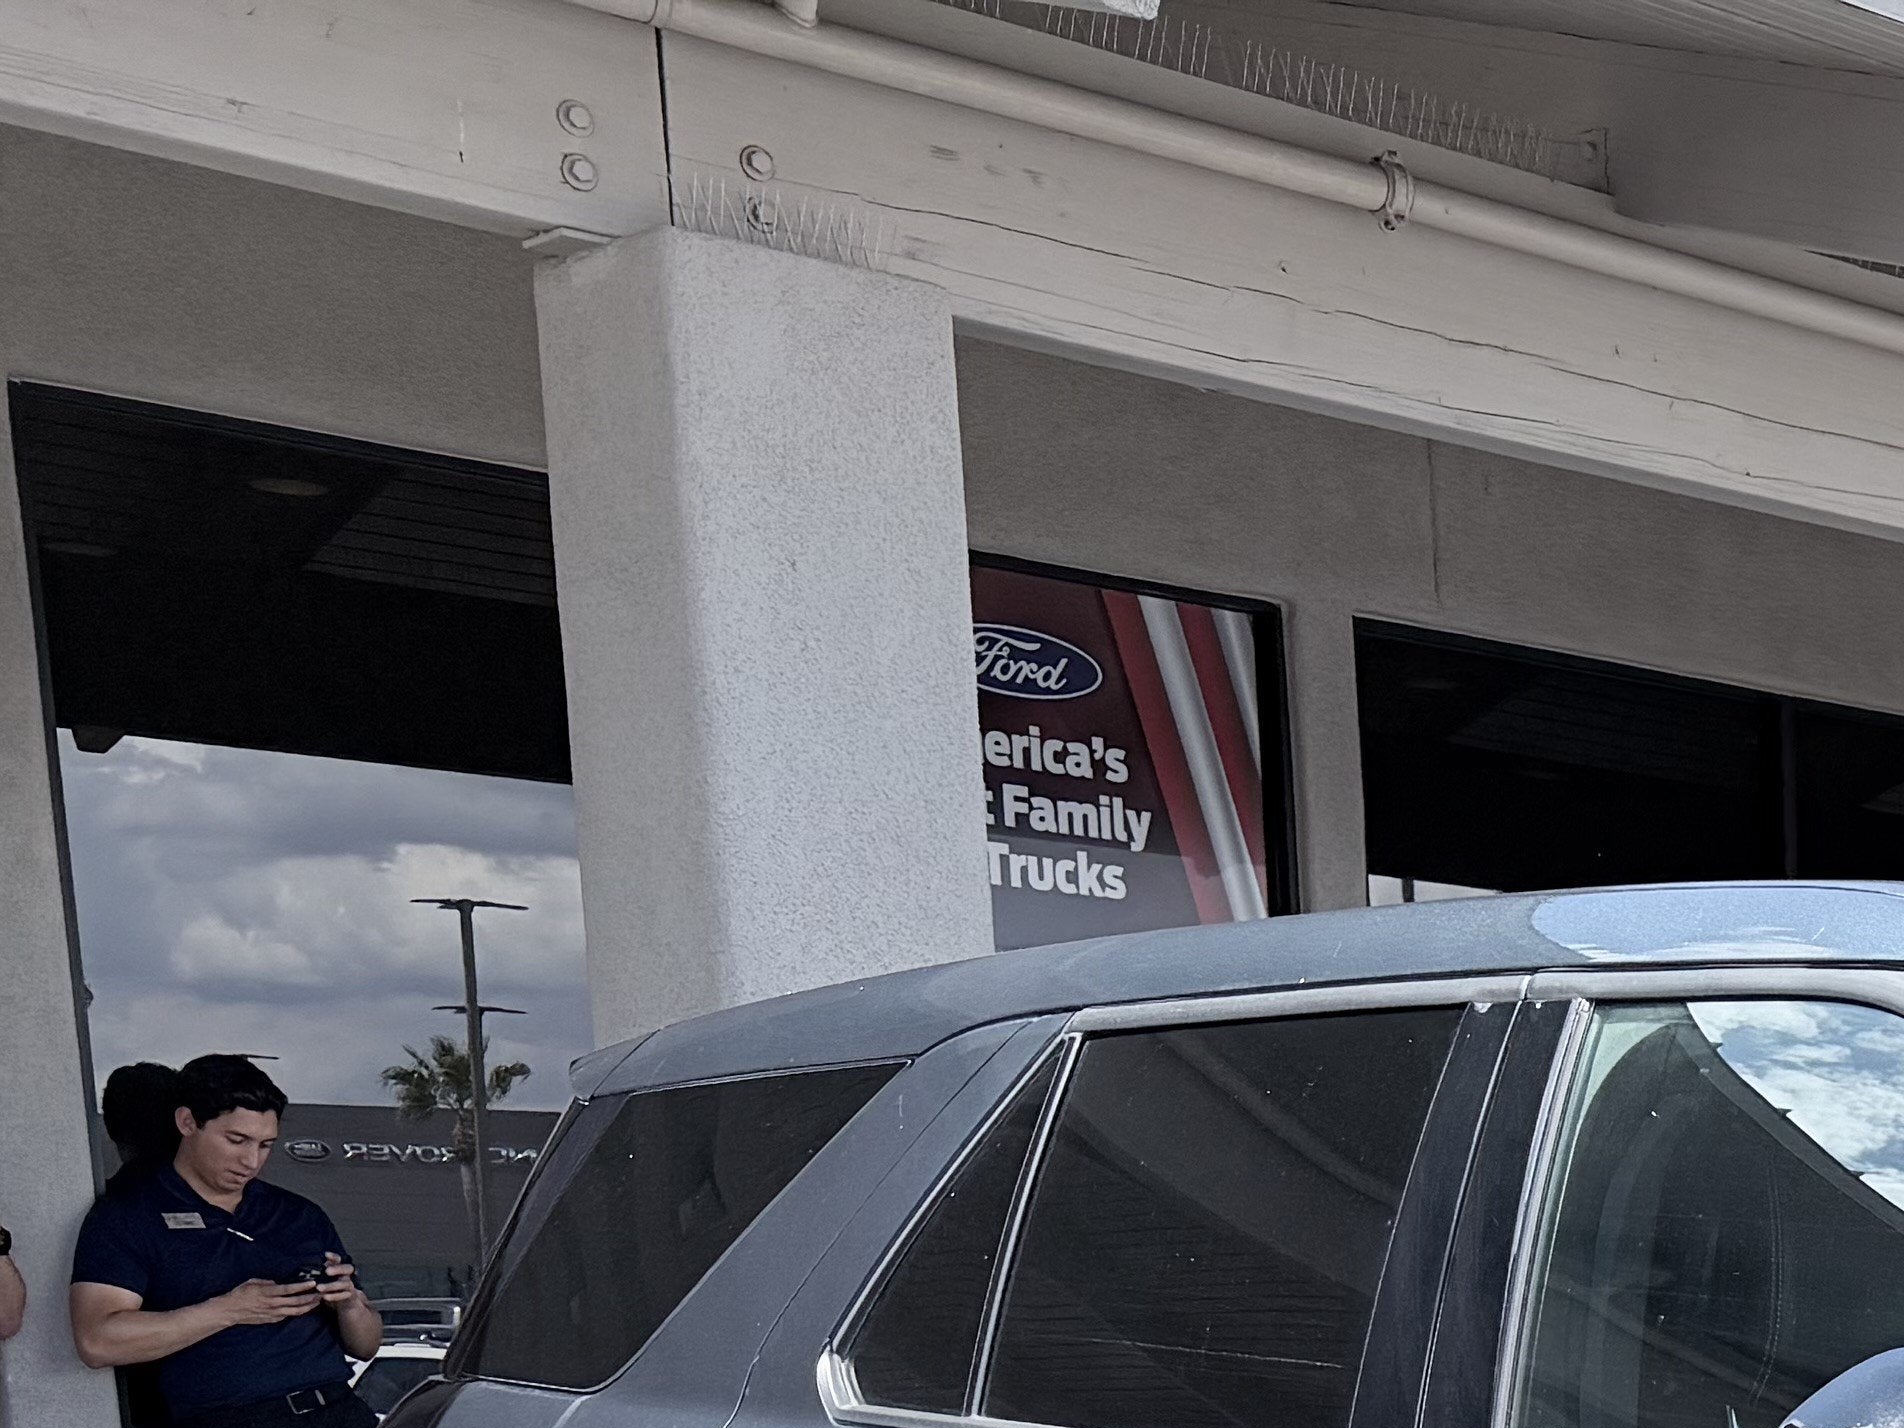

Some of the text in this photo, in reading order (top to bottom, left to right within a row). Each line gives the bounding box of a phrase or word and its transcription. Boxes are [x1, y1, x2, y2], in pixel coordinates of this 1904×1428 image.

[974, 631, 1069, 690] Ford
[982, 725, 1129, 783] erica's
[1002, 783, 1152, 852] Family
[987, 841, 1128, 900] Trucks
